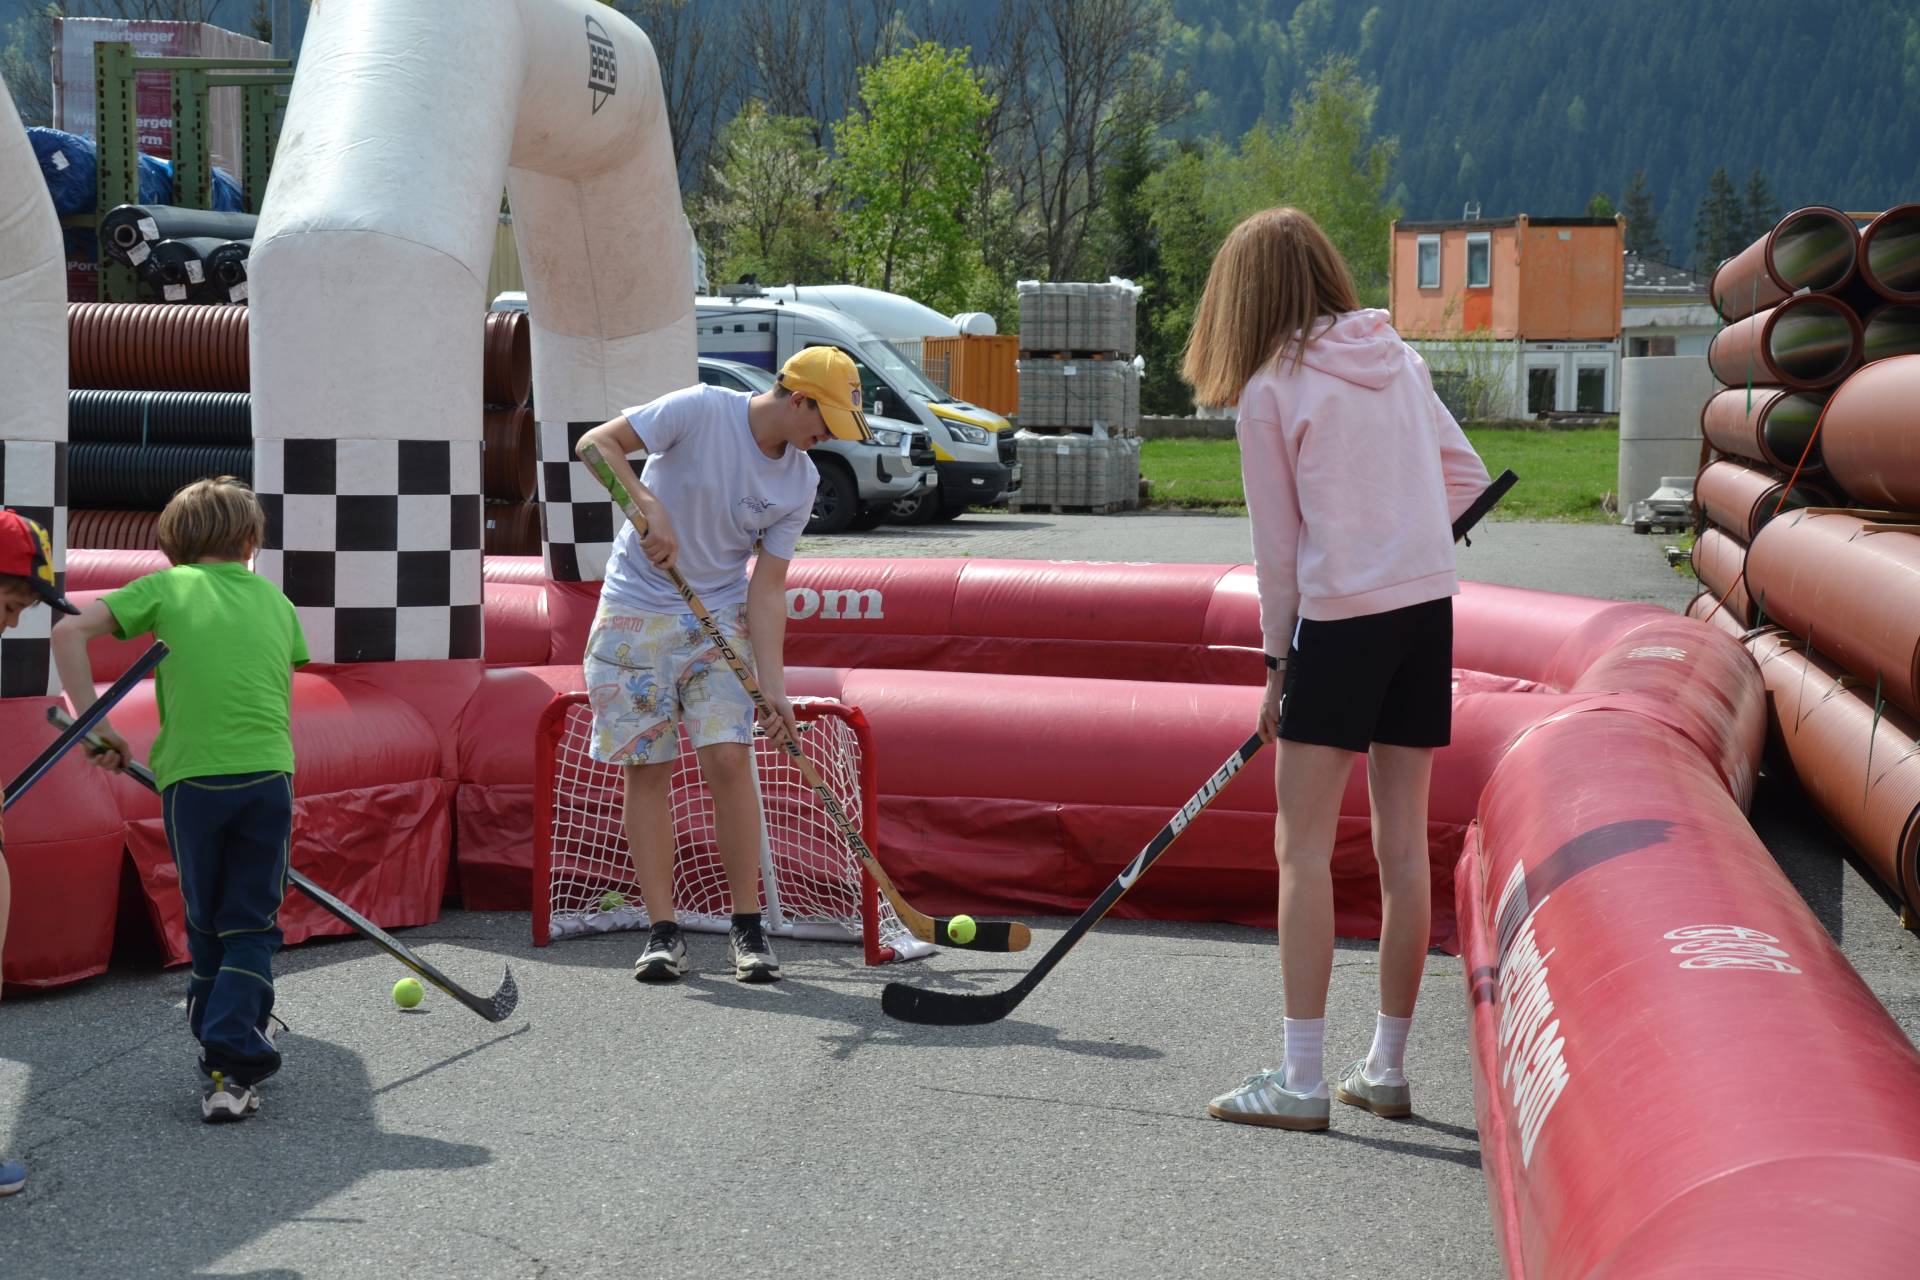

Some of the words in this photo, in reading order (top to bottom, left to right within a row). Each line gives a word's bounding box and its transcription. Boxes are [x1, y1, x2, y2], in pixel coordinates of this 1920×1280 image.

[590, 43, 617, 84] BERG
[784, 587, 884, 620] om
[814, 786, 871, 859] FISCHER
